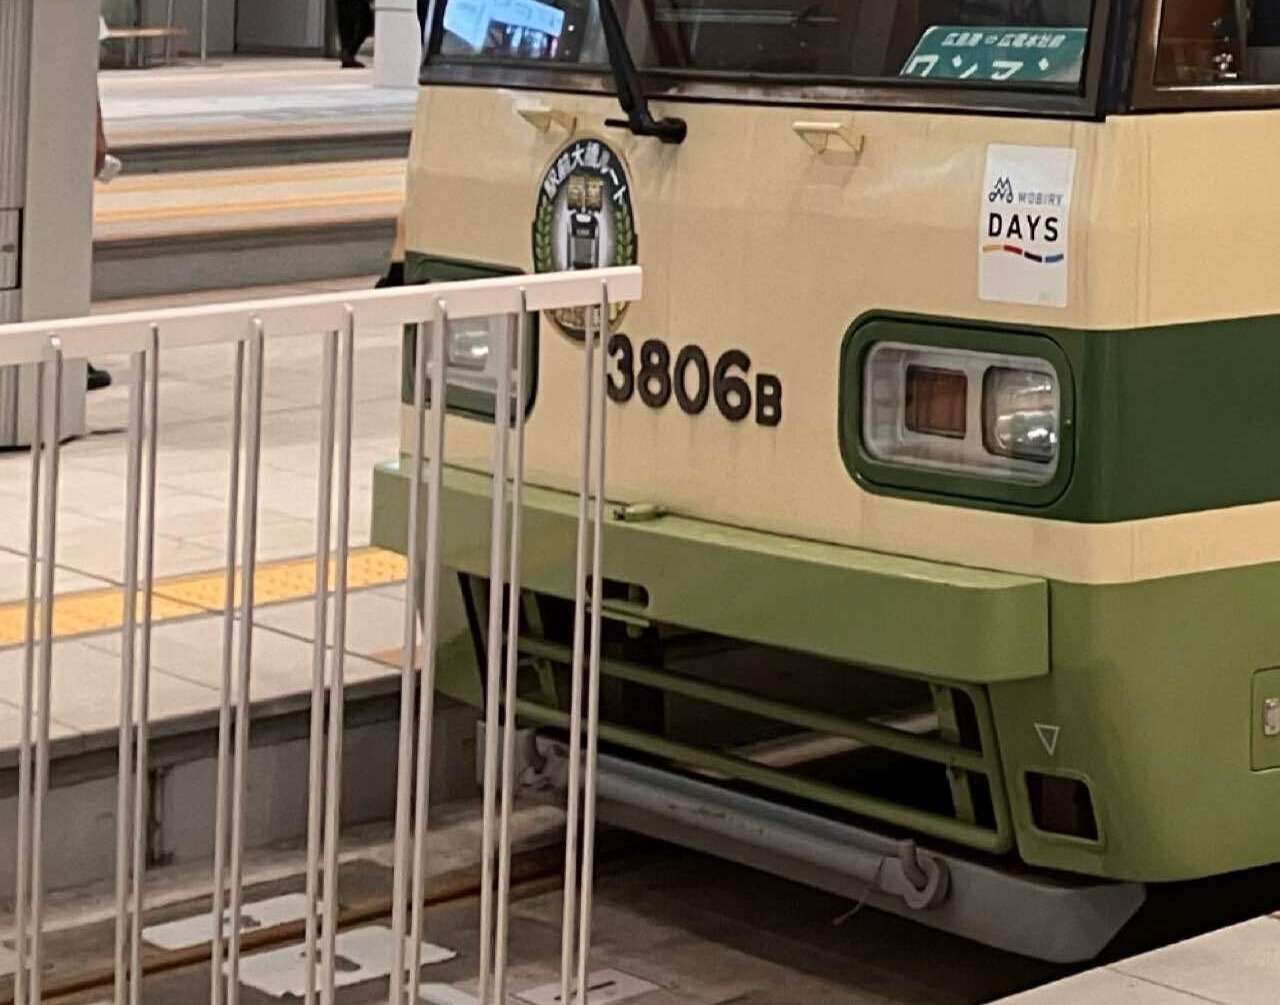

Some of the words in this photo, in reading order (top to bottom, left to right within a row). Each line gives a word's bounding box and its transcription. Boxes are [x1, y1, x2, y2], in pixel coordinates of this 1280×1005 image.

[1018, 191, 1064, 207] MOBIRY
[988, 213, 1059, 242] DAYS
[607, 333, 782, 427] 3806B
